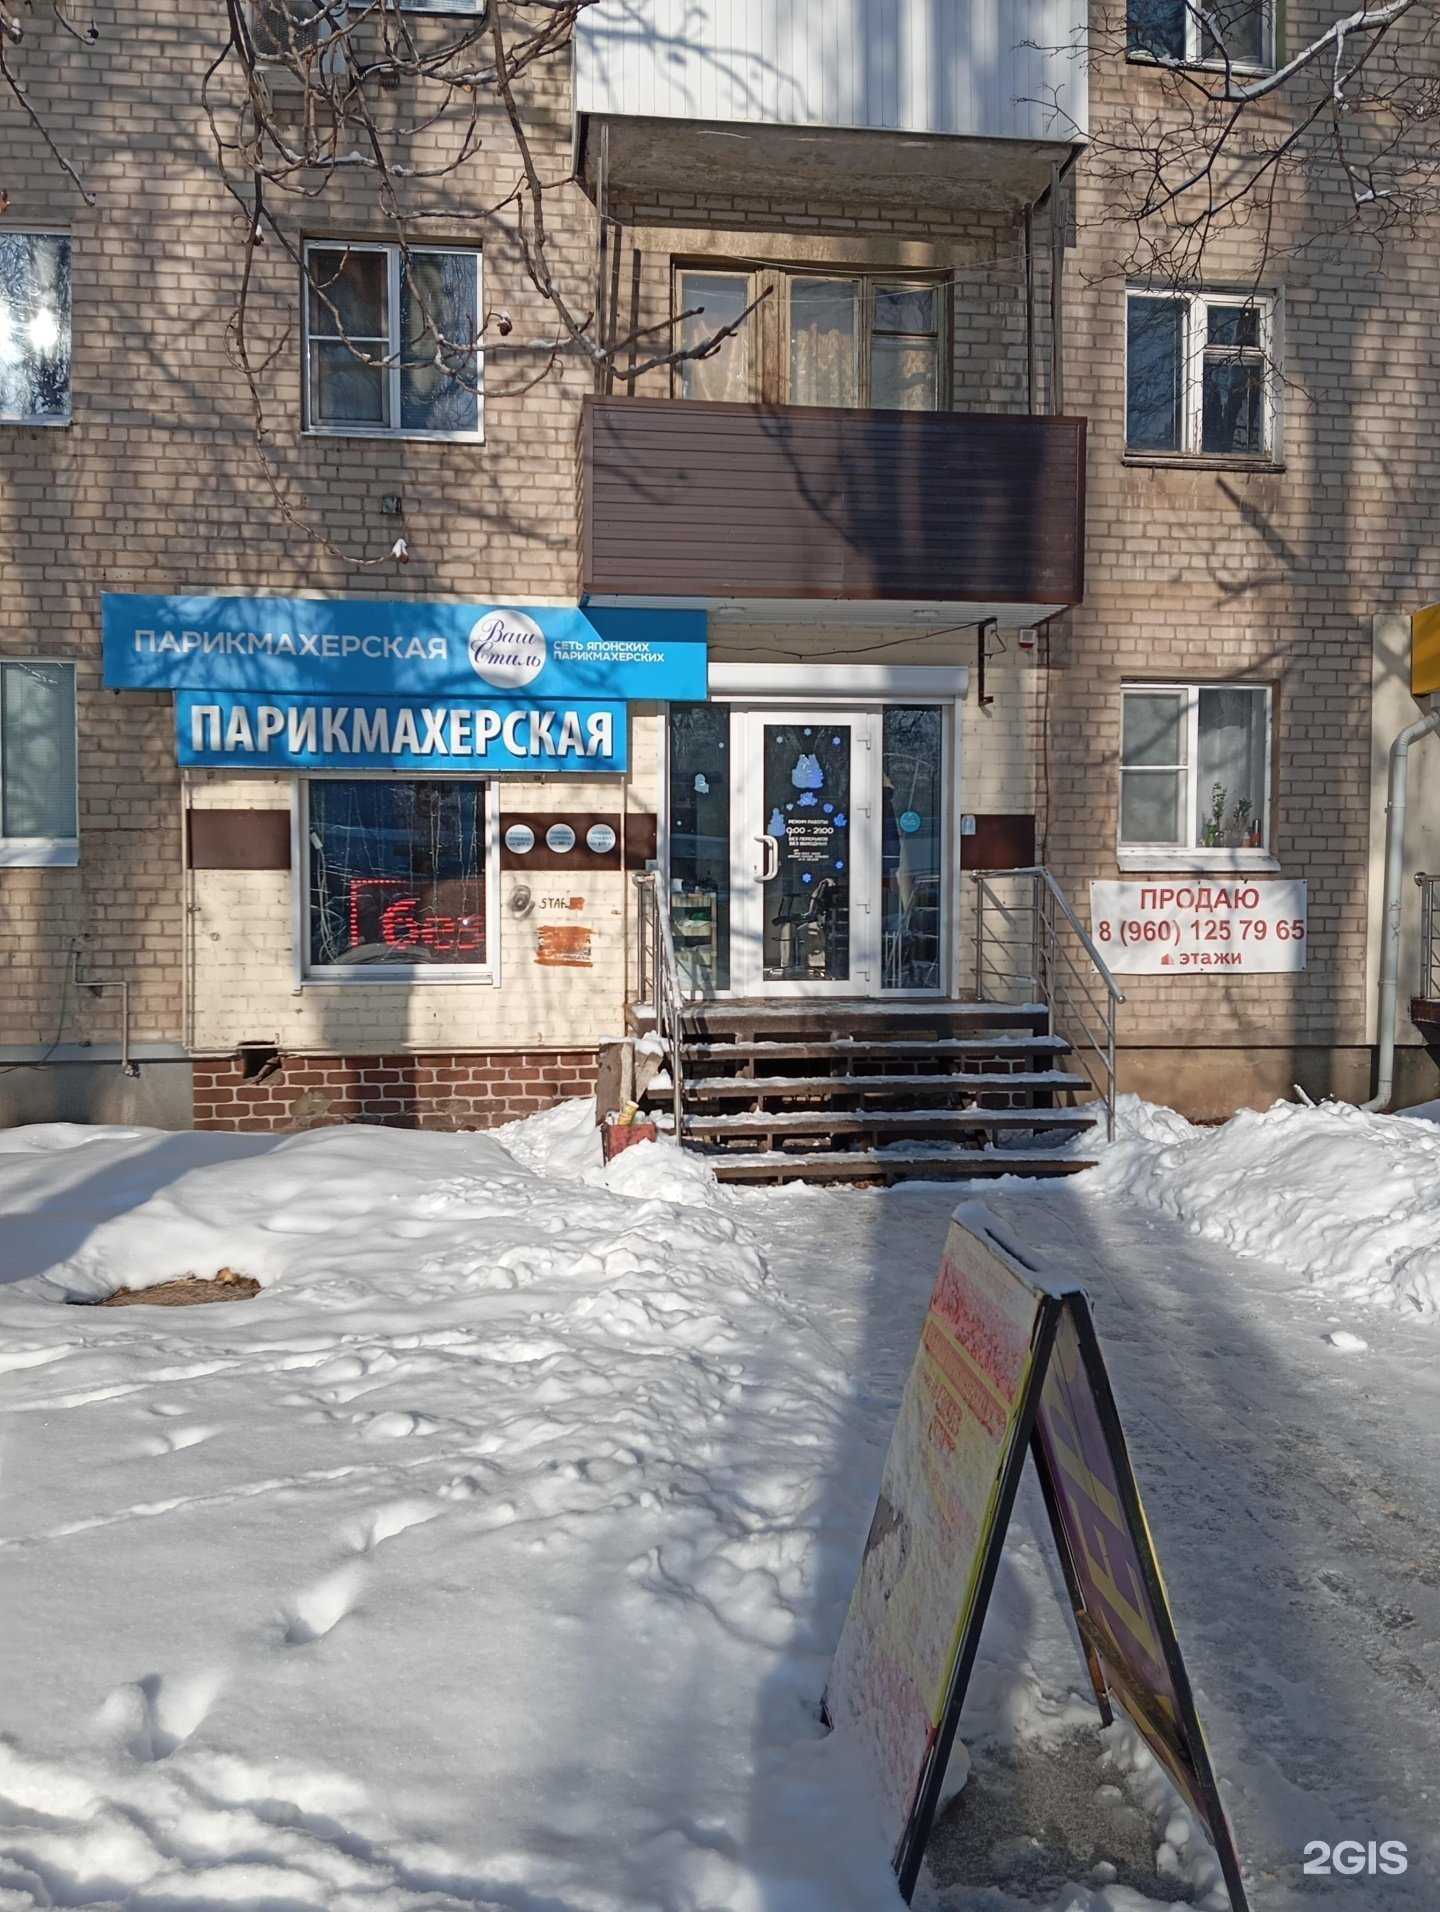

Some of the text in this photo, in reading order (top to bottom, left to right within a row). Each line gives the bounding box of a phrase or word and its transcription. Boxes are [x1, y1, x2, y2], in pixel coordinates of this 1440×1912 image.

[134, 629, 448, 660] ПАРИКМАХЕРСКАЯ
[482, 619, 537, 646] Ваш
[470, 640, 541, 668] Стиль
[553, 640, 650, 653] СЕТЬ ЯПОНСКИХ
[553, 651, 665, 663] ПАРИКМАХЕРСКИХ
[191, 704, 613, 758] ПАРИКМАХЕРСКАЯ
[1140, 887, 1260, 913] ПРОДАЮ
[1098, 919, 1305, 947] 8 (960) 125 79 65
[1179, 952, 1242, 966] этажи
